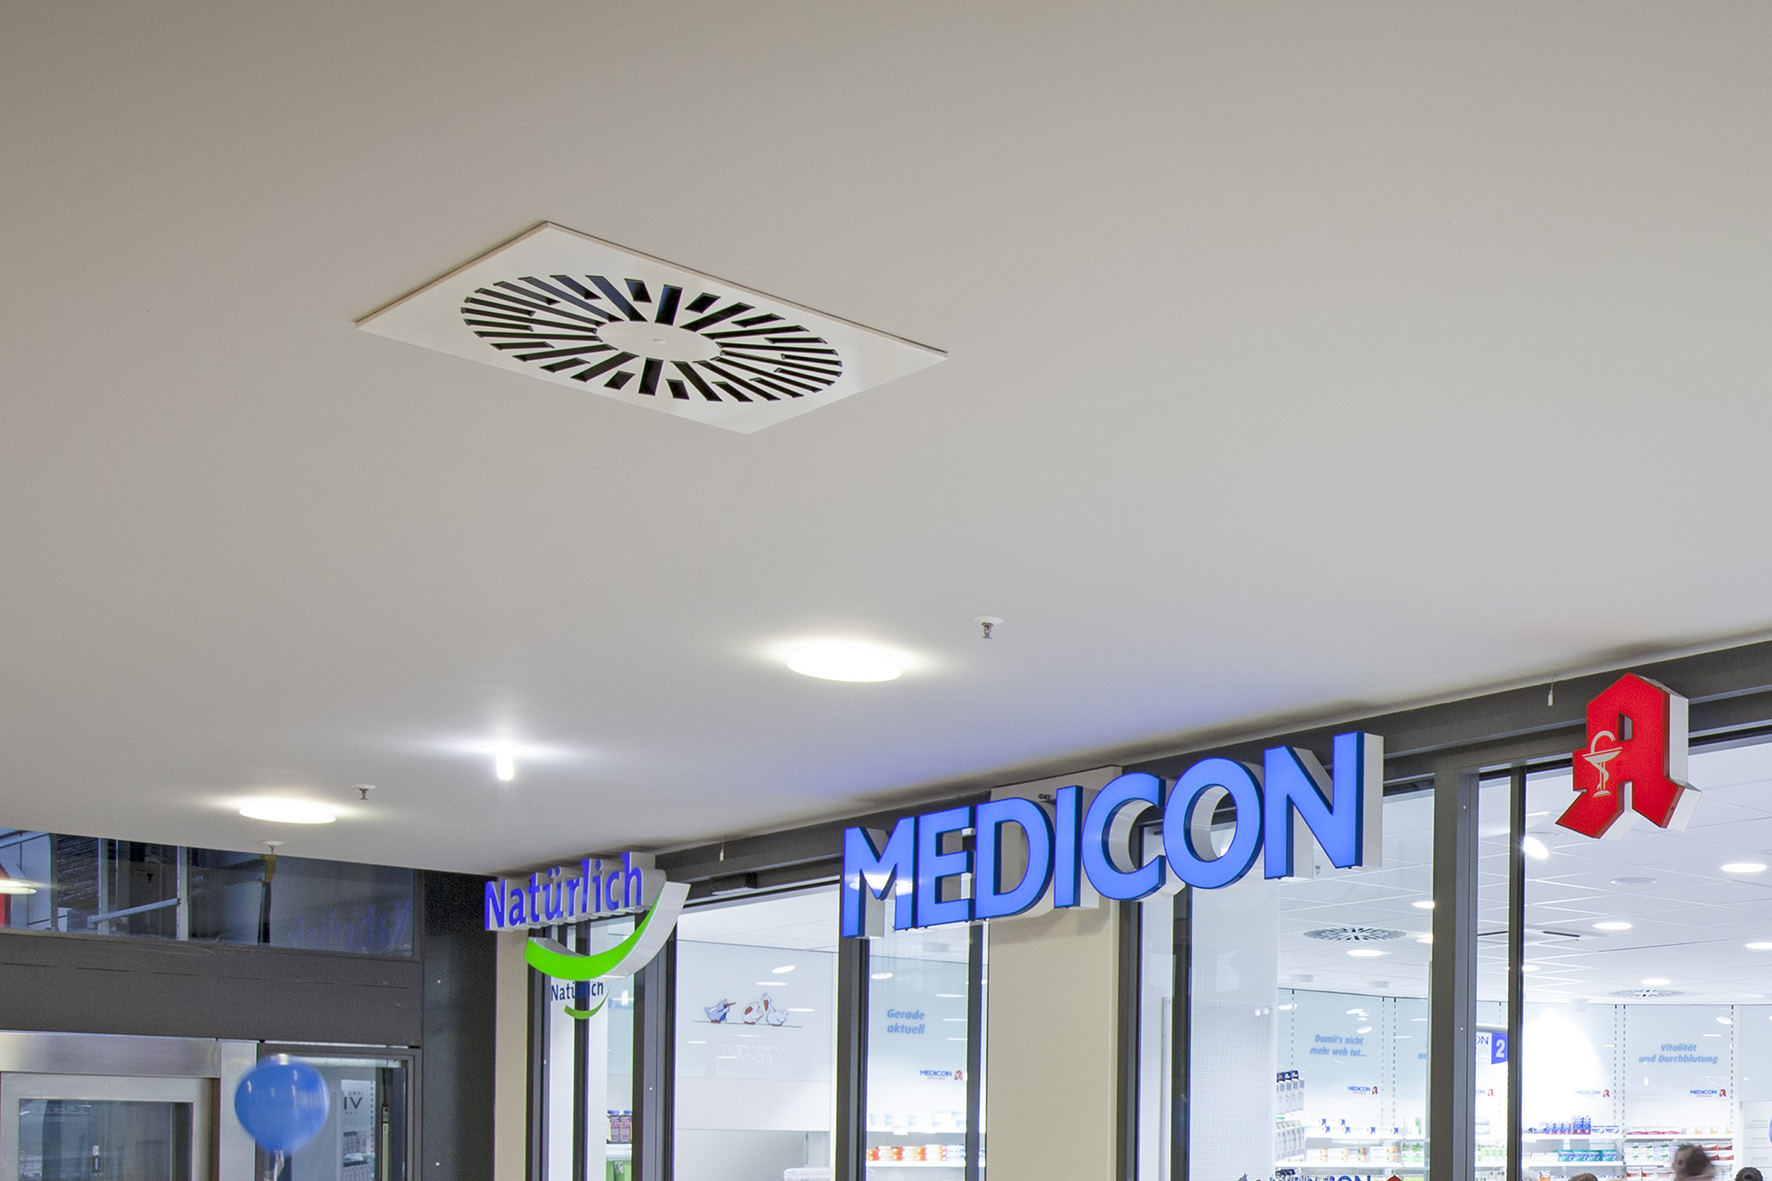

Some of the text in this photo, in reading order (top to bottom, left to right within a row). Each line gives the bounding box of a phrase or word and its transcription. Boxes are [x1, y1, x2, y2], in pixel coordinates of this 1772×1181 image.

[842, 731, 1368, 938] MEDICON
[485, 851, 643, 930] Natürlich
[887, 1009, 925, 1020] Gerade
[887, 1023, 925, 1034] aktuell
[1495, 1039, 1506, 1058] 2
[1660, 1043, 1697, 1052] Vitalität
[1638, 1055, 1718, 1065] und Durchblutung
